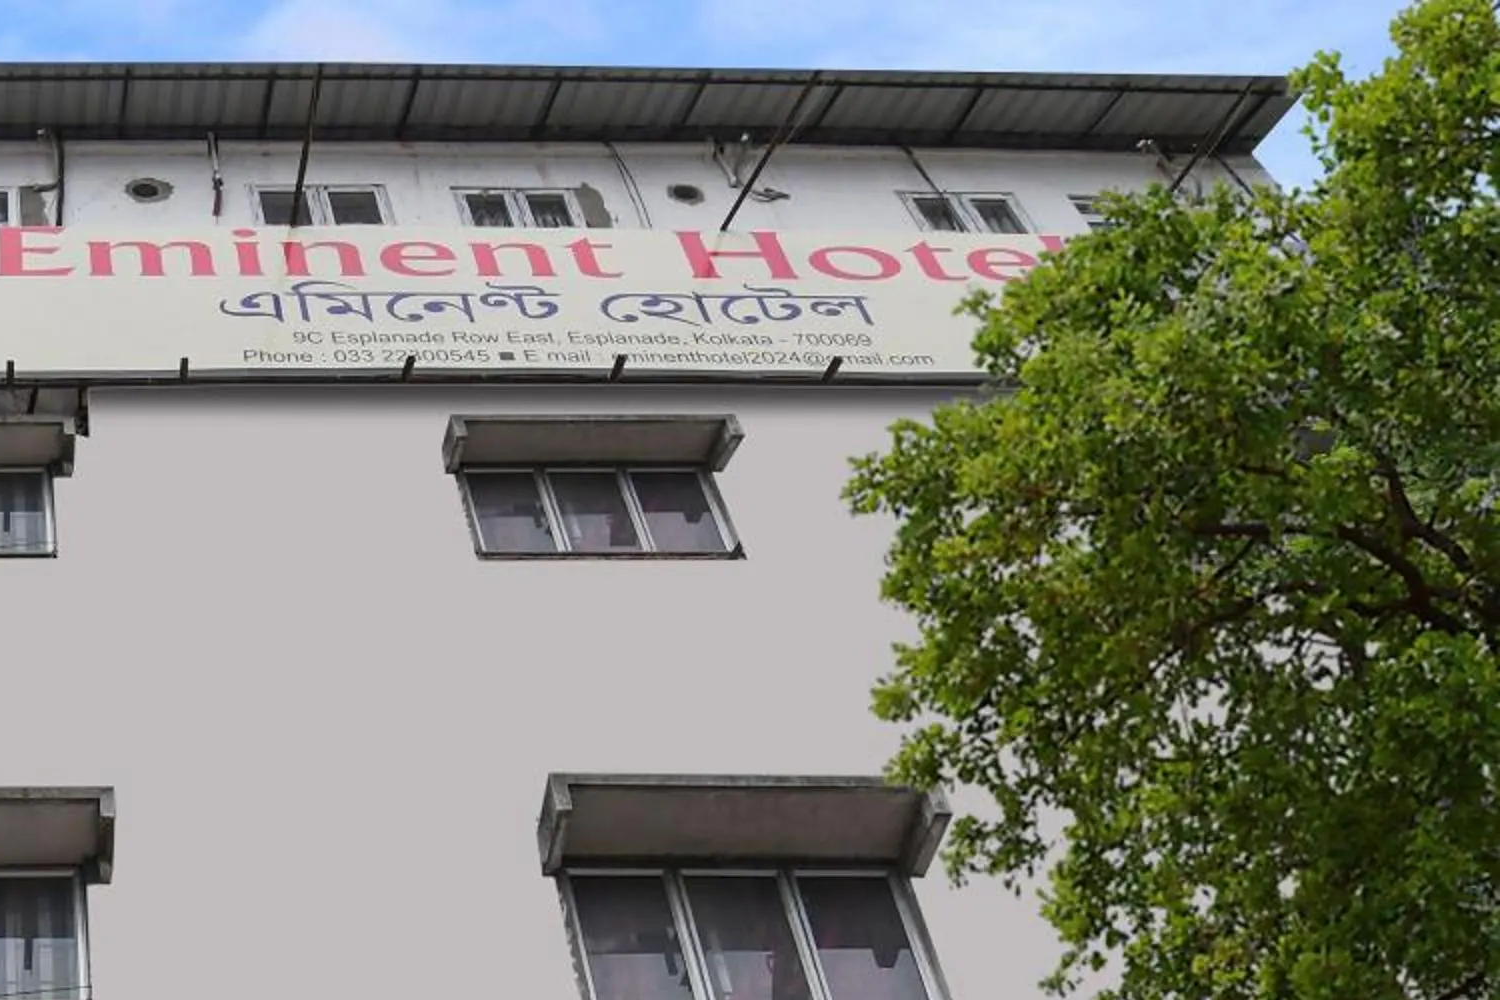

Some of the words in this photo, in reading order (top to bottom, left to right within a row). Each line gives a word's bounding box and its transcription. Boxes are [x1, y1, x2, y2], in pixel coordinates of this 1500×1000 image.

[219, 280, 561, 323] এমিনেন্ট
[600, 283, 875, 326] হোটেল
[293, 331, 323, 344] 9C
[331, 331, 445, 346] Esplanade
[452, 331, 499, 344] Row
[693, 331, 774, 346] Kolkata
[243, 349, 313, 363] Phone
[334, 349, 375, 363] 033
[548, 350, 592, 363] mail
